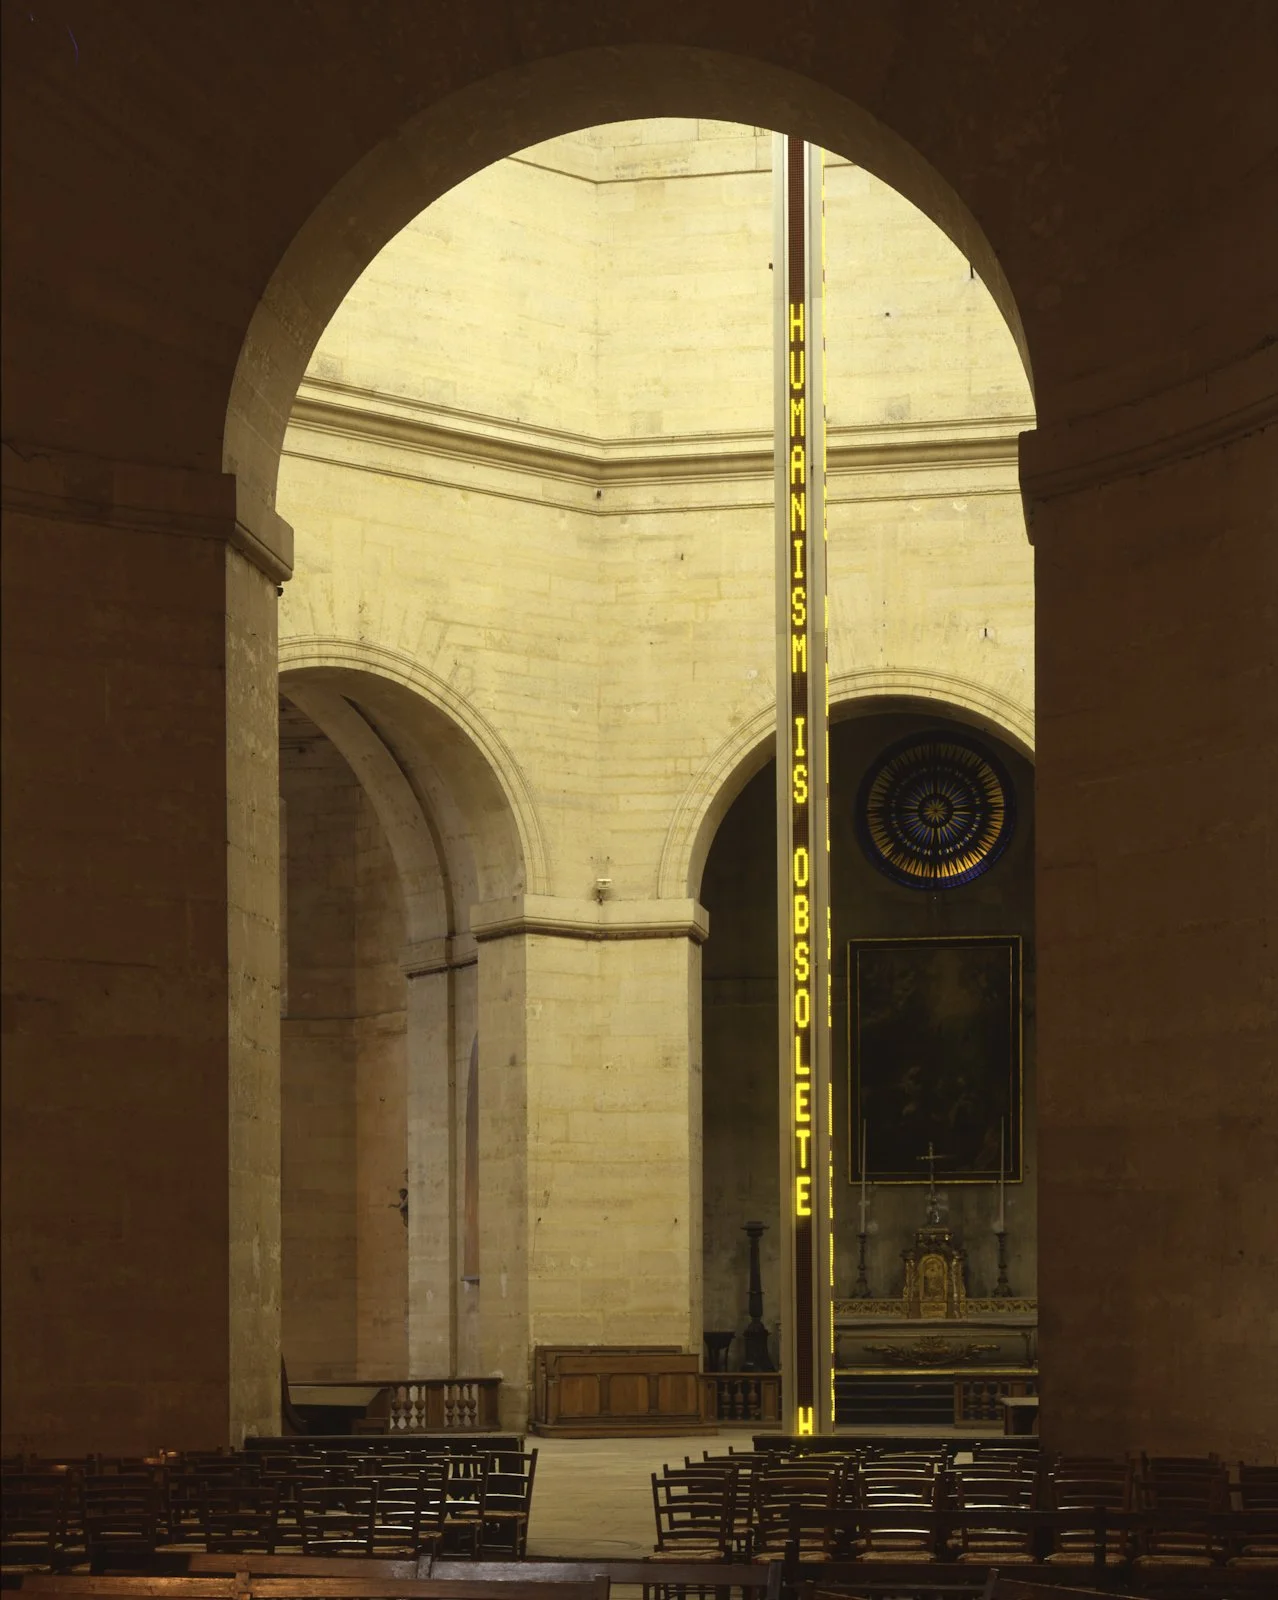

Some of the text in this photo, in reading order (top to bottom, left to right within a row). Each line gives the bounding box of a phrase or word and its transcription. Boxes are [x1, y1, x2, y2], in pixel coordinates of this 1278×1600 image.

[790, 303, 807, 673] HUMANISM
[793, 717, 808, 804] IS
[793, 847, 811, 1217] OBSOLETE
